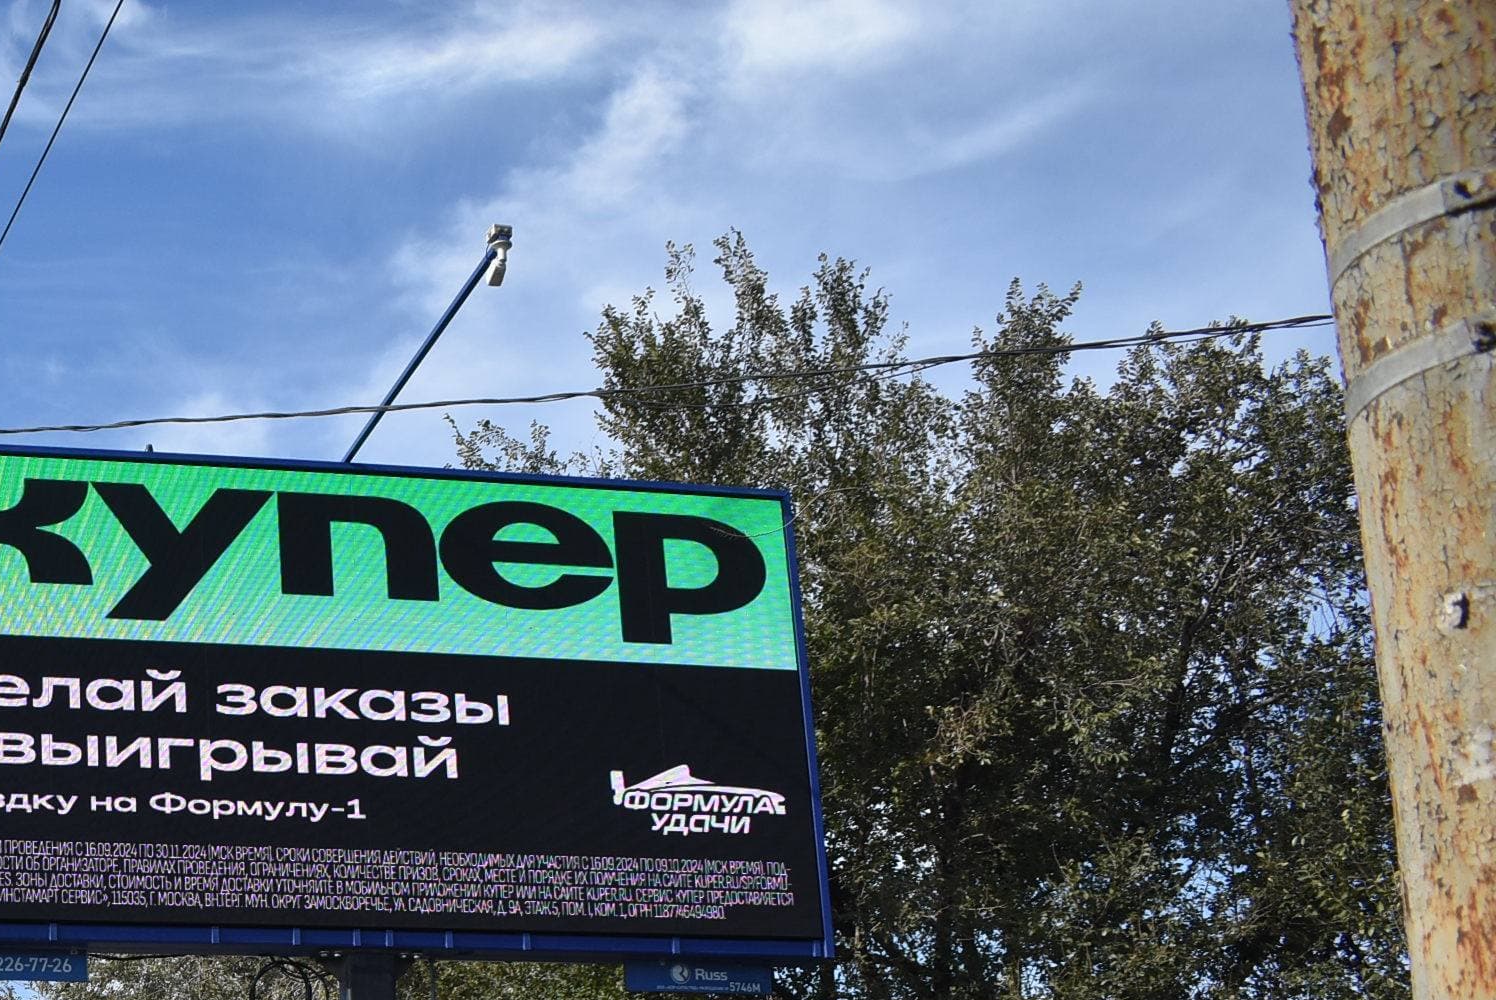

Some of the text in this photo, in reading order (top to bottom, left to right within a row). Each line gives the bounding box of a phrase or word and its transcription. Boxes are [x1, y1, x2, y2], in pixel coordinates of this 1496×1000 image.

[216, 683, 510, 726] заказы
[90, 795, 137, 812] на
[149, 792, 366, 822] Формулу-1
[624, 791, 775, 815] ФОРМУЛА
[651, 814, 751, 836] УДАЧИ
[4, 840, 74, 857] ПРОВЕДЕНИЯ
[84, 842, 138, 858] 16.09.2024
[138, 843, 154, 859] ПО
[276, 847, 310, 863] СРОКИ
[312, 848, 380, 865] СОВЕРШЕНИЯ
[440, 852, 515, 869] НЕОБХОДИМЫХ
[516, 854, 534, 871] ДЛЯ
[536, 854, 580, 871] УЧАСТИЯ
[640, 857, 654, 873] ПО
[26, 856, 40, 871] ОБ
[42, 857, 122, 876] ОРГАНИЗАТОРЕ,
[124, 859, 176, 875] ПРАВИЛАХ
[178, 860, 248, 879] ПРОВЕДЕНИЯ,
[250, 862, 331, 881] ОГРАНИЧЕНИЯХ,
[334, 864, 396, 881] КОЛИЧЕСТВЕ
[484, 868, 516, 884] МЕСТЕ
[528, 869, 573, 885] ПОРЯДКЕ
[574, 871, 589, 886] ИХ
[590, 871, 646, 887] ПОЛУЧЕНИЯ
[648, 873, 662, 888] НА
[15, 872, 48, 887] ЗОНЫ
[50, 873, 106, 891] ДОСТАВКИ,
[108, 874, 172, 891] СТОИМОСТЬ
[184, 876, 219, 892] ВРЕМЯ
[220, 877, 274, 894] ДОСТАВКИ
[276, 877, 334, 895] УТОЧНЯЙТЕ
[345, 881, 410, 897] МОБИЛЬНОМ
[412, 882, 482, 899] ПРИЛОЖЕНИИ
[484, 884, 514, 899] КУПЕР
[538, 885, 552, 900] НА
[635, 888, 674, 903] СЕРВИС
[676, 889, 704, 904] КУПЕР
[706, 890, 794, 907] ПРЕДОСТАВЛЯЕТСЯ
[111, 890, 148, 908] 115035,
[158, 891, 203, 910] МОСКВА,
[272, 894, 302, 910] ОКРУГ
[304, 895, 392, 914] ЗАМОСКВОРЕЧЬЕ,
[524, 900, 552, 916] ЭТАЖ
[628, 903, 652, 918] ОГРН
[695, 967, 728, 981] Russ
